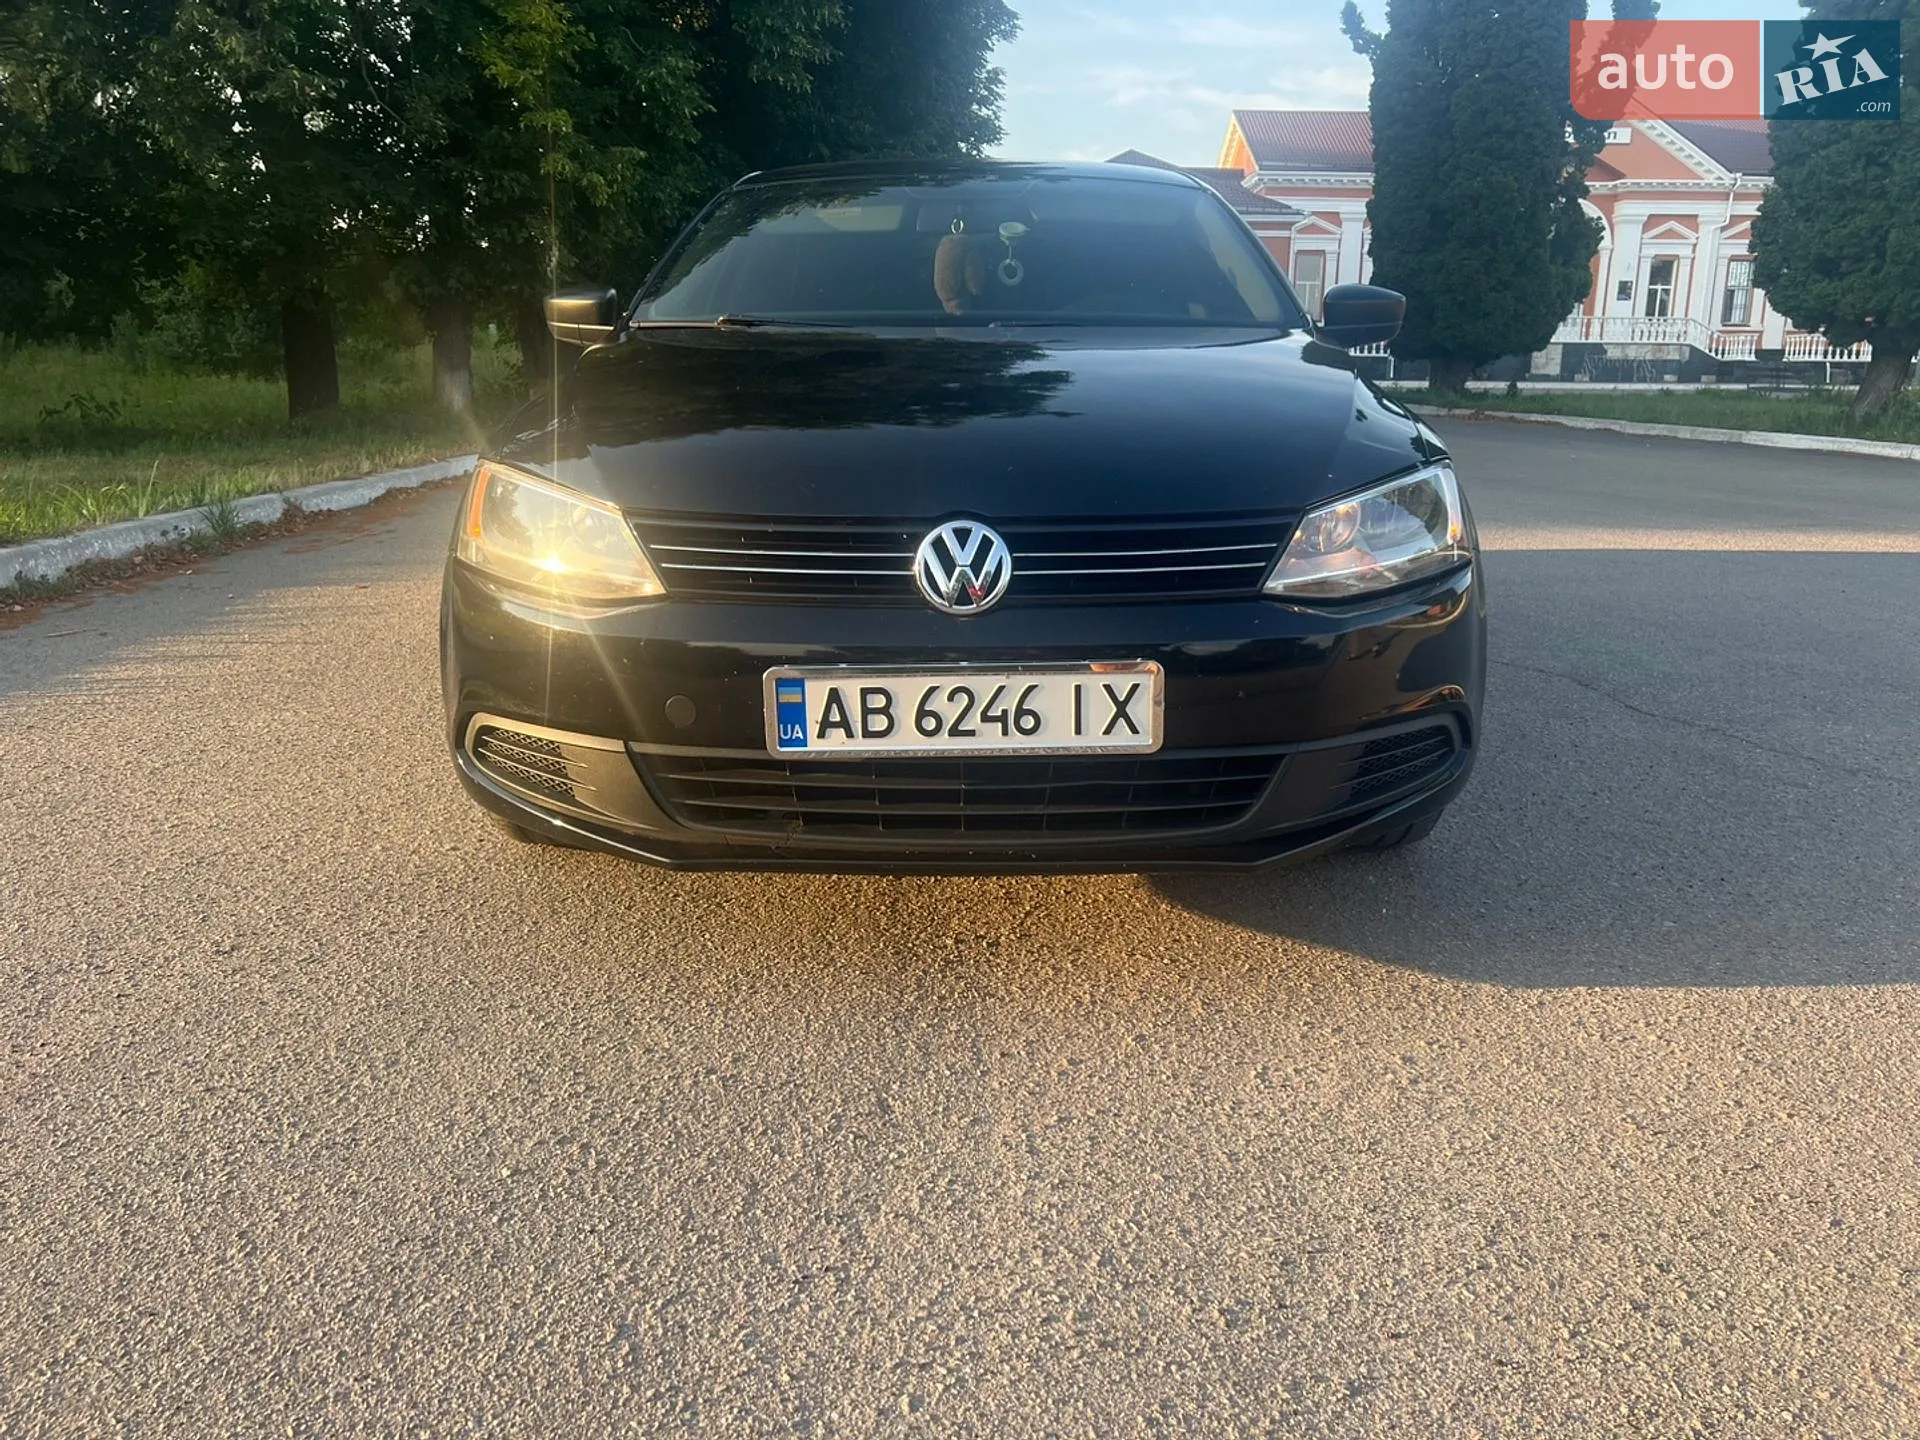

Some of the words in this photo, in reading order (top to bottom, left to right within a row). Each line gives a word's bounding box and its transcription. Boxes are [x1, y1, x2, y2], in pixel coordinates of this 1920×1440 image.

[816, 686, 895, 739] AB
[914, 684, 1042, 738] 6246
[1073, 683, 1141, 736] IX
[780, 724, 804, 740] UA
